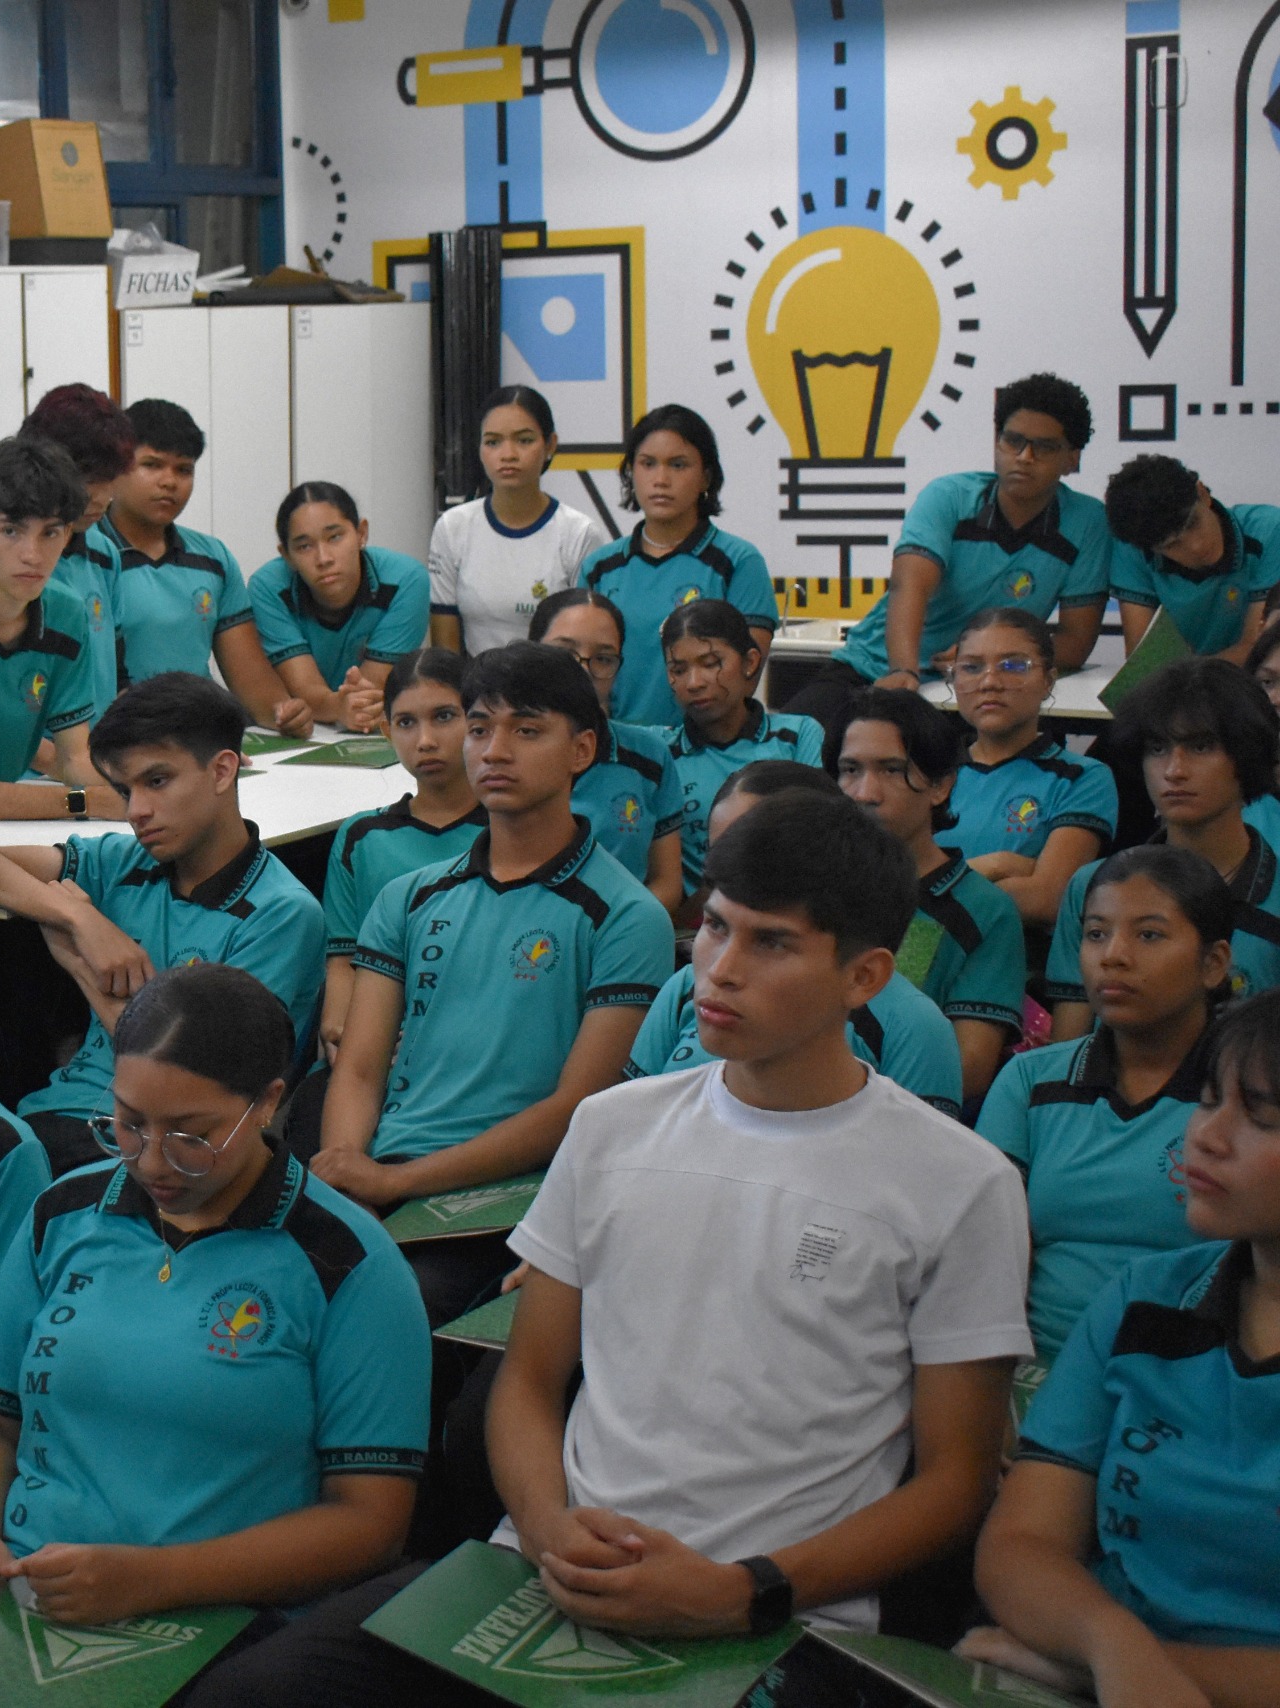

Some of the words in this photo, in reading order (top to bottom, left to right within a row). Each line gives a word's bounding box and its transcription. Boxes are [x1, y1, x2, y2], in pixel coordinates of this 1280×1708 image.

[127, 272, 192, 294] FICHAS
[608, 992, 649, 1002] RAMOS
[8, 1271, 94, 1529] FORMANDO
[343, 1451, 400, 1464] RAMOS
